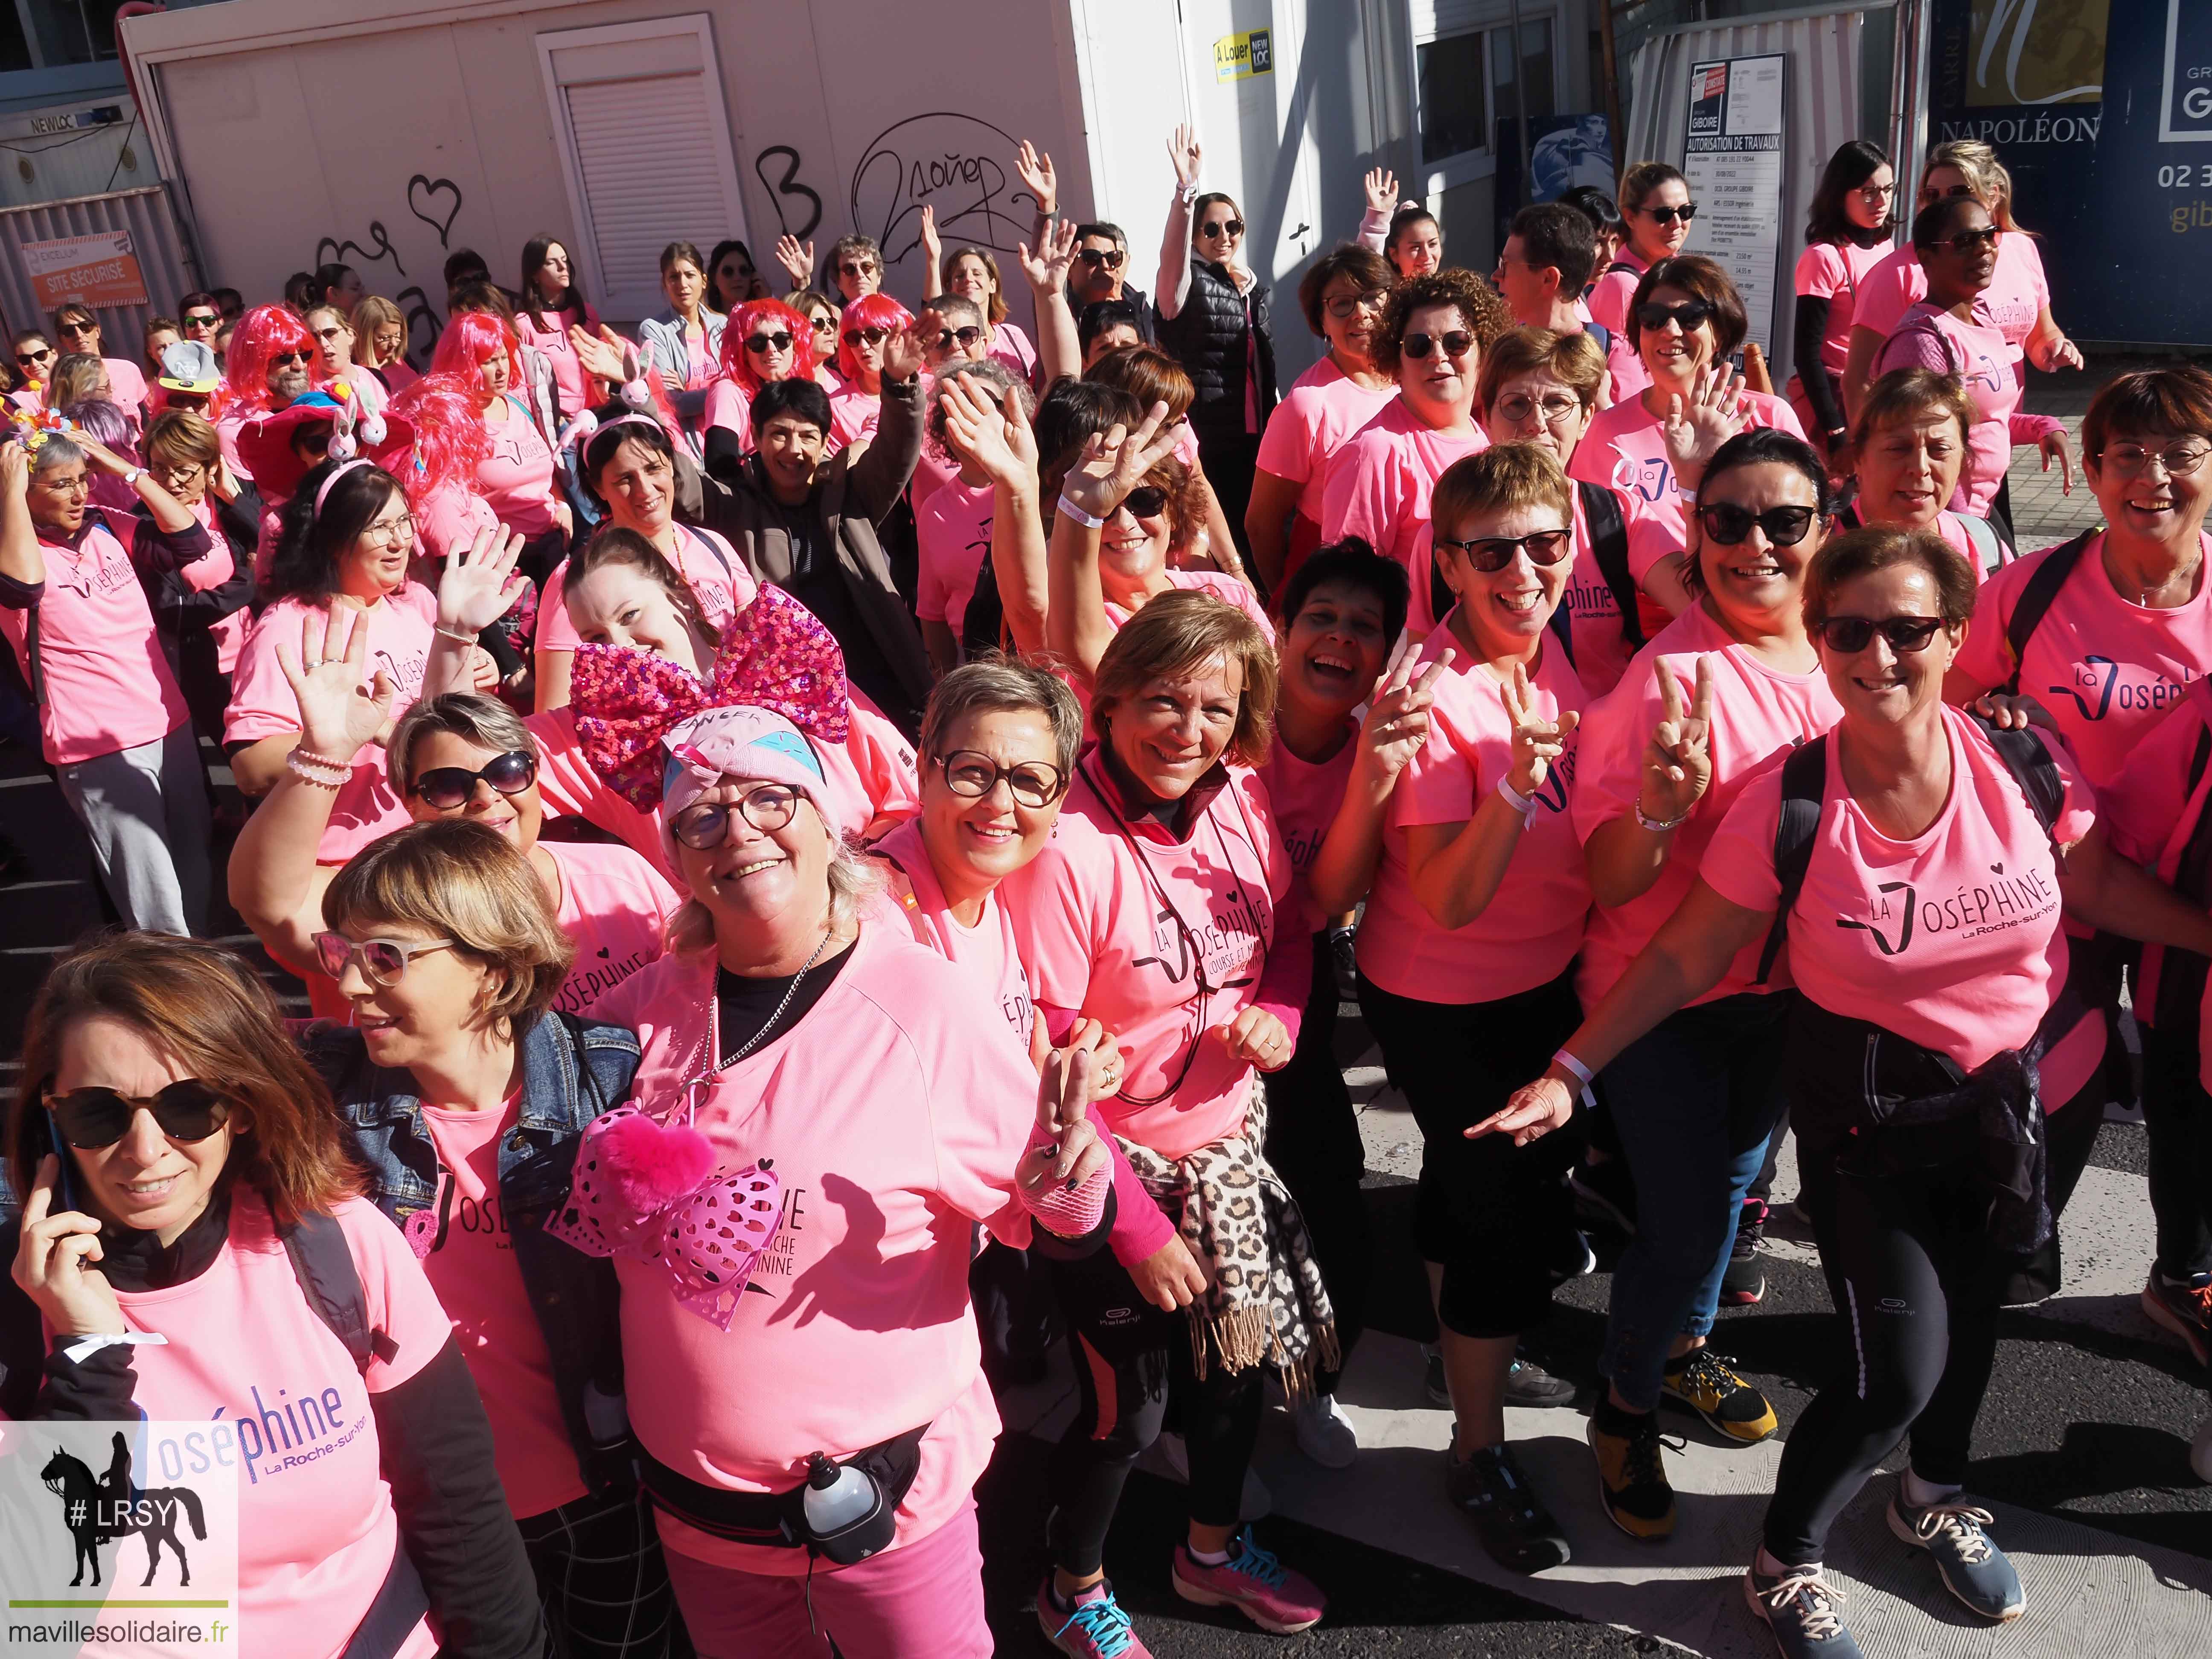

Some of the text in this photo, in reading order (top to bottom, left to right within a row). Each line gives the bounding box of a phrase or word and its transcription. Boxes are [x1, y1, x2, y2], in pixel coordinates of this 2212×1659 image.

[1224, 44, 1248, 62] Louer
[1252, 39, 1268, 51] NEW
[1253, 50, 1269, 66] LOC
[1692, 116, 1717, 128] GIBOIRE
[1941, 111, 2099, 144] NAPOLÉON
[1687, 136, 1779, 151] AUTORISATION DE TRAVAUX
[2158, 165, 2192, 187] 02
[47, 273, 70, 294] SITE
[70, 258, 125, 289] SÉCURISÉ
[2075, 667, 2097, 687] la
[1870, 897, 1891, 921] LA
[1962, 901, 2058, 939] La Roche-sur-Yon
[1155, 928, 1171, 952] LA
[1208, 953, 1235, 975] COURSE
[1237, 947, 1244, 962] ET
[265, 1415, 367, 1475] La Roche-sur-Yon
